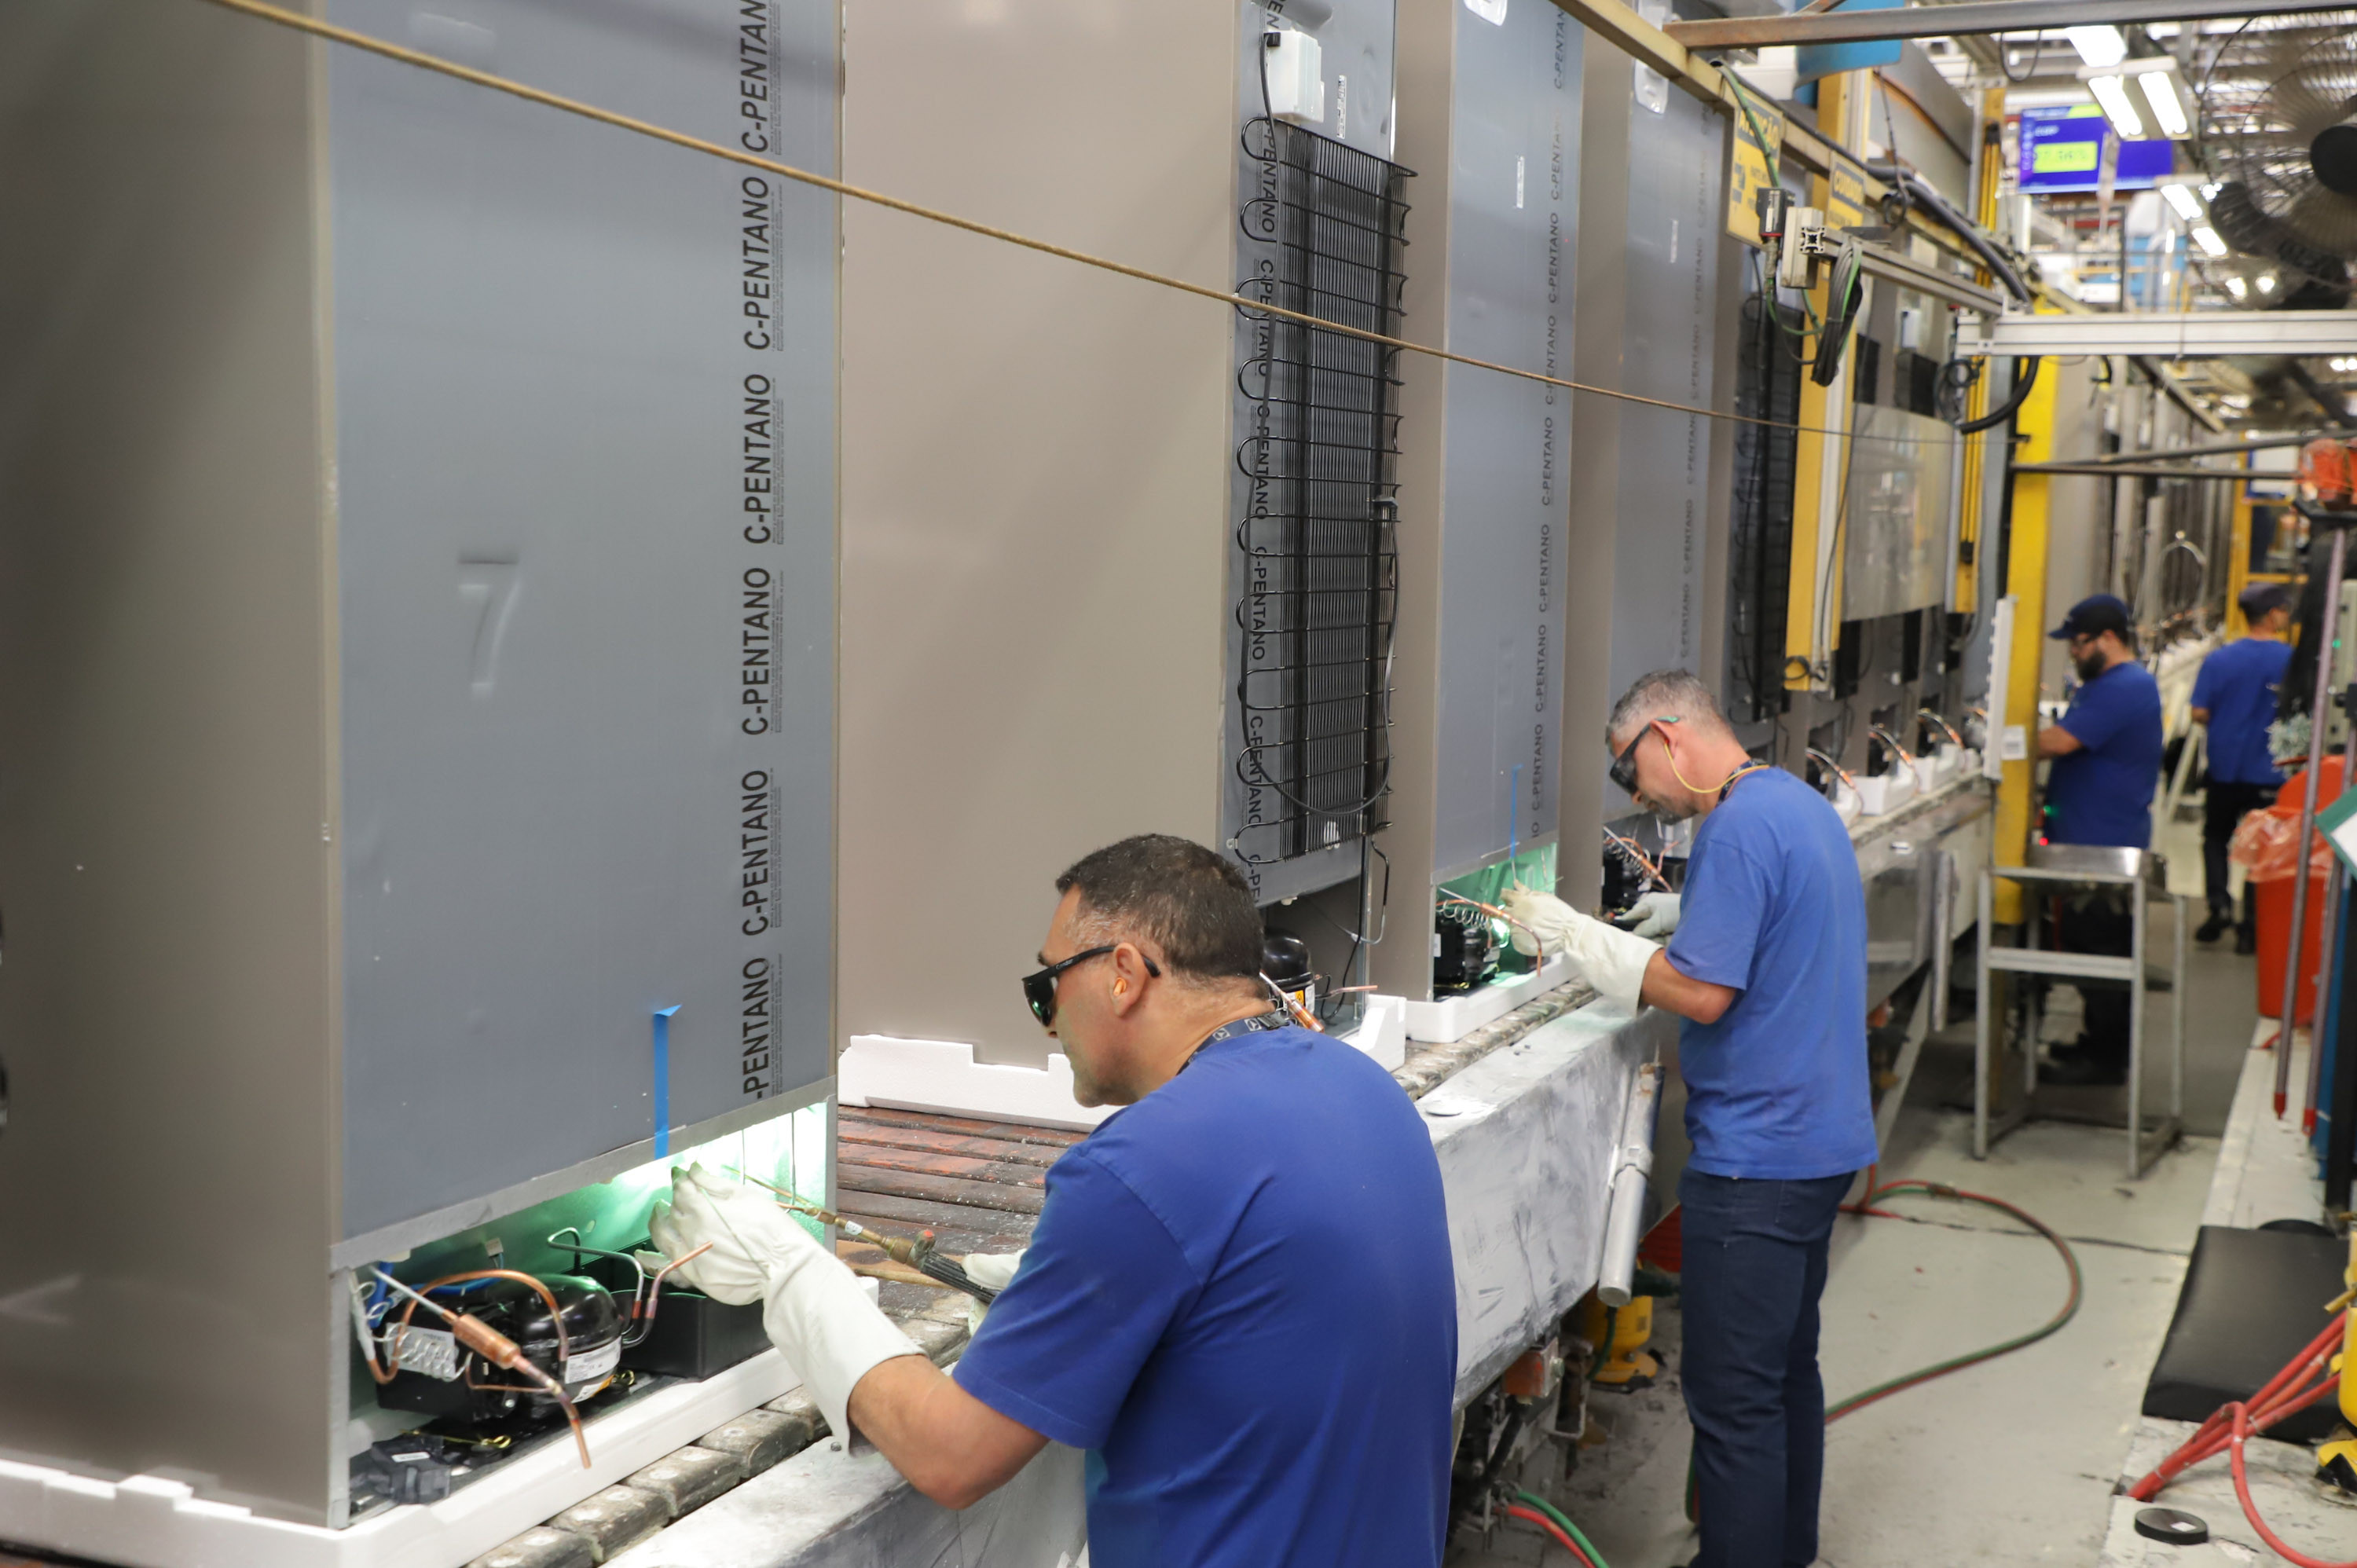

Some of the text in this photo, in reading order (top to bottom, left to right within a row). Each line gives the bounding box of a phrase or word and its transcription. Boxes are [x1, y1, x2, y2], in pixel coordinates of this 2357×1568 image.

[1548, 211, 1560, 302] C-PENTANO
[1541, 416, 1553, 505] C-PENTANO
[739, 0, 772, 1100] -PENTANO C-PENTANO C-PENTANO C-PENTANO C-PENTANO C-PENTAN
[1538, 523, 1550, 611] C-PENTANO
[457, 553, 521, 694] 7
[1534, 624, 1547, 712] C-PENTANO
[1531, 723, 1544, 810] C-PENTANO
